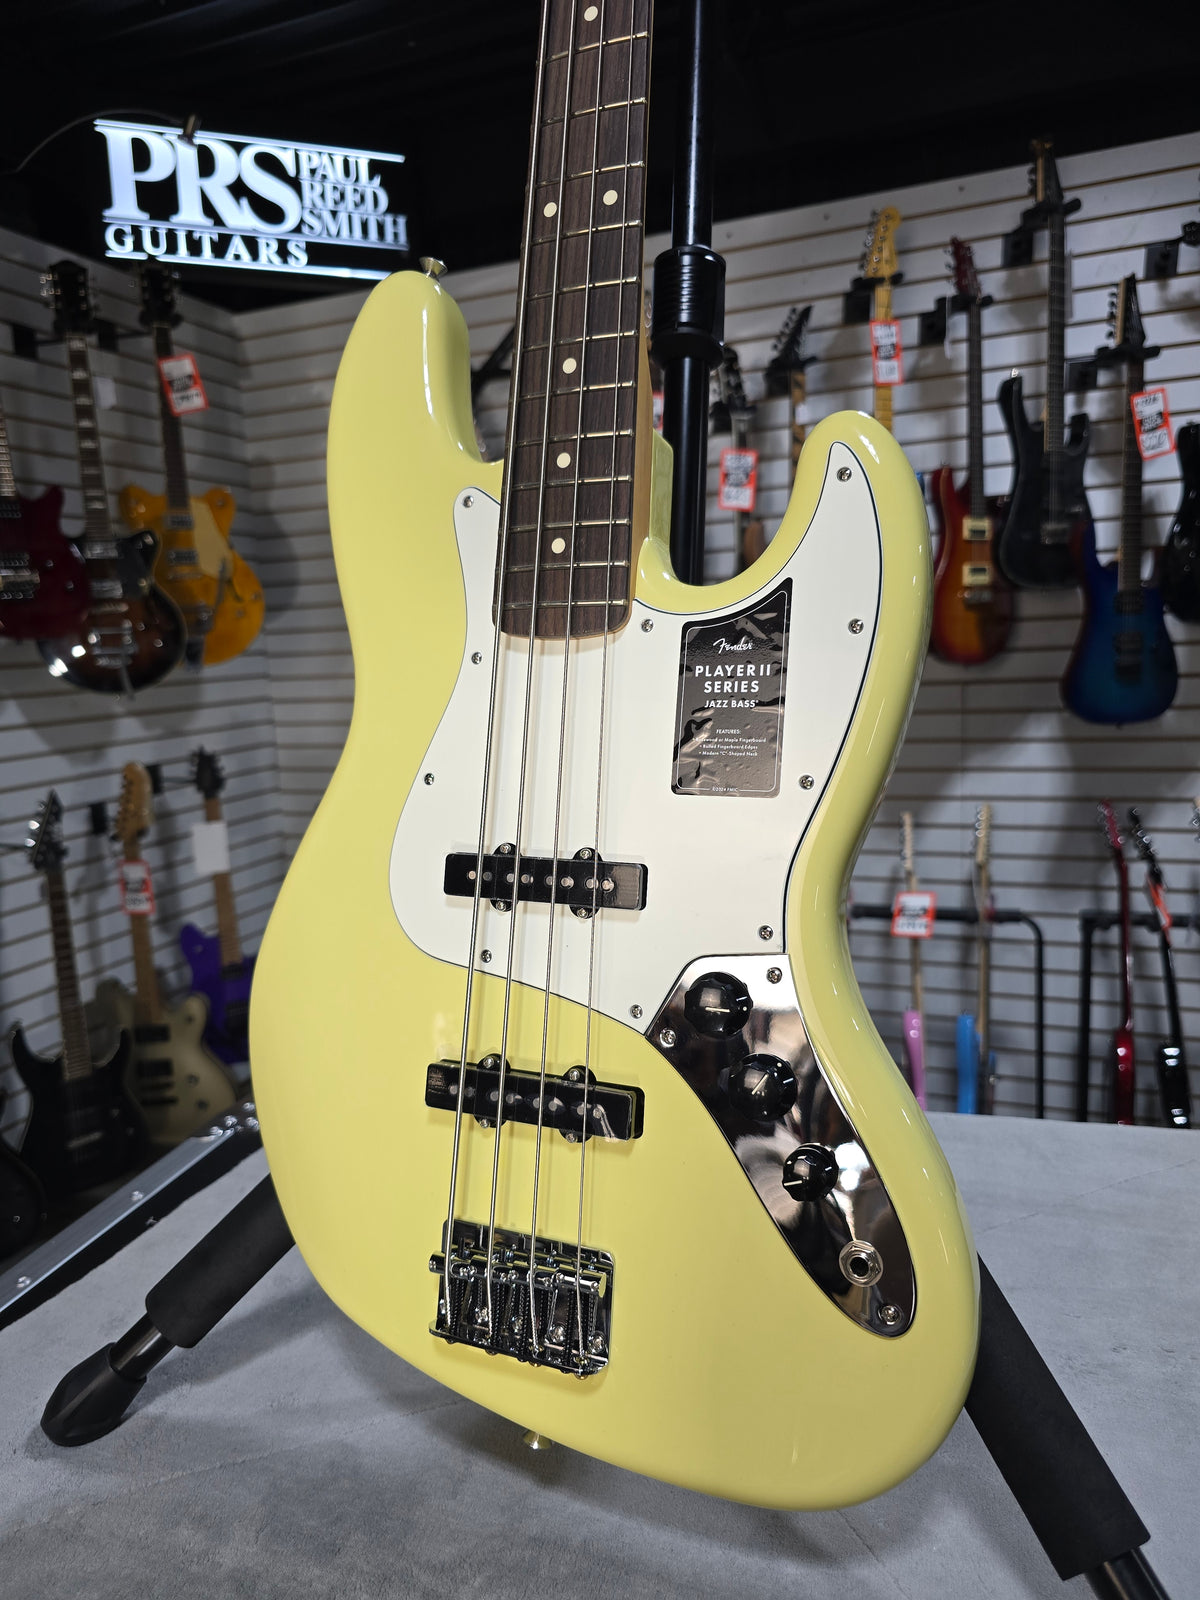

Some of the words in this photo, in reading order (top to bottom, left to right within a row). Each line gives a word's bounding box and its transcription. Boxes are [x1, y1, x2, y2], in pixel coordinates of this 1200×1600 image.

[95, 125, 302, 234] PRS
[297, 149, 381, 187] PAUL
[300, 179, 389, 215] REED
[300, 207, 408, 245] SMITH
[105, 223, 309, 267] GUITARS
[713, 635, 753, 654] Fender
[695, 664, 756, 677] PLAYER
[759, 664, 771, 676] II
[704, 681, 759, 693] SERIES
[704, 700, 728, 708] JAZZ
